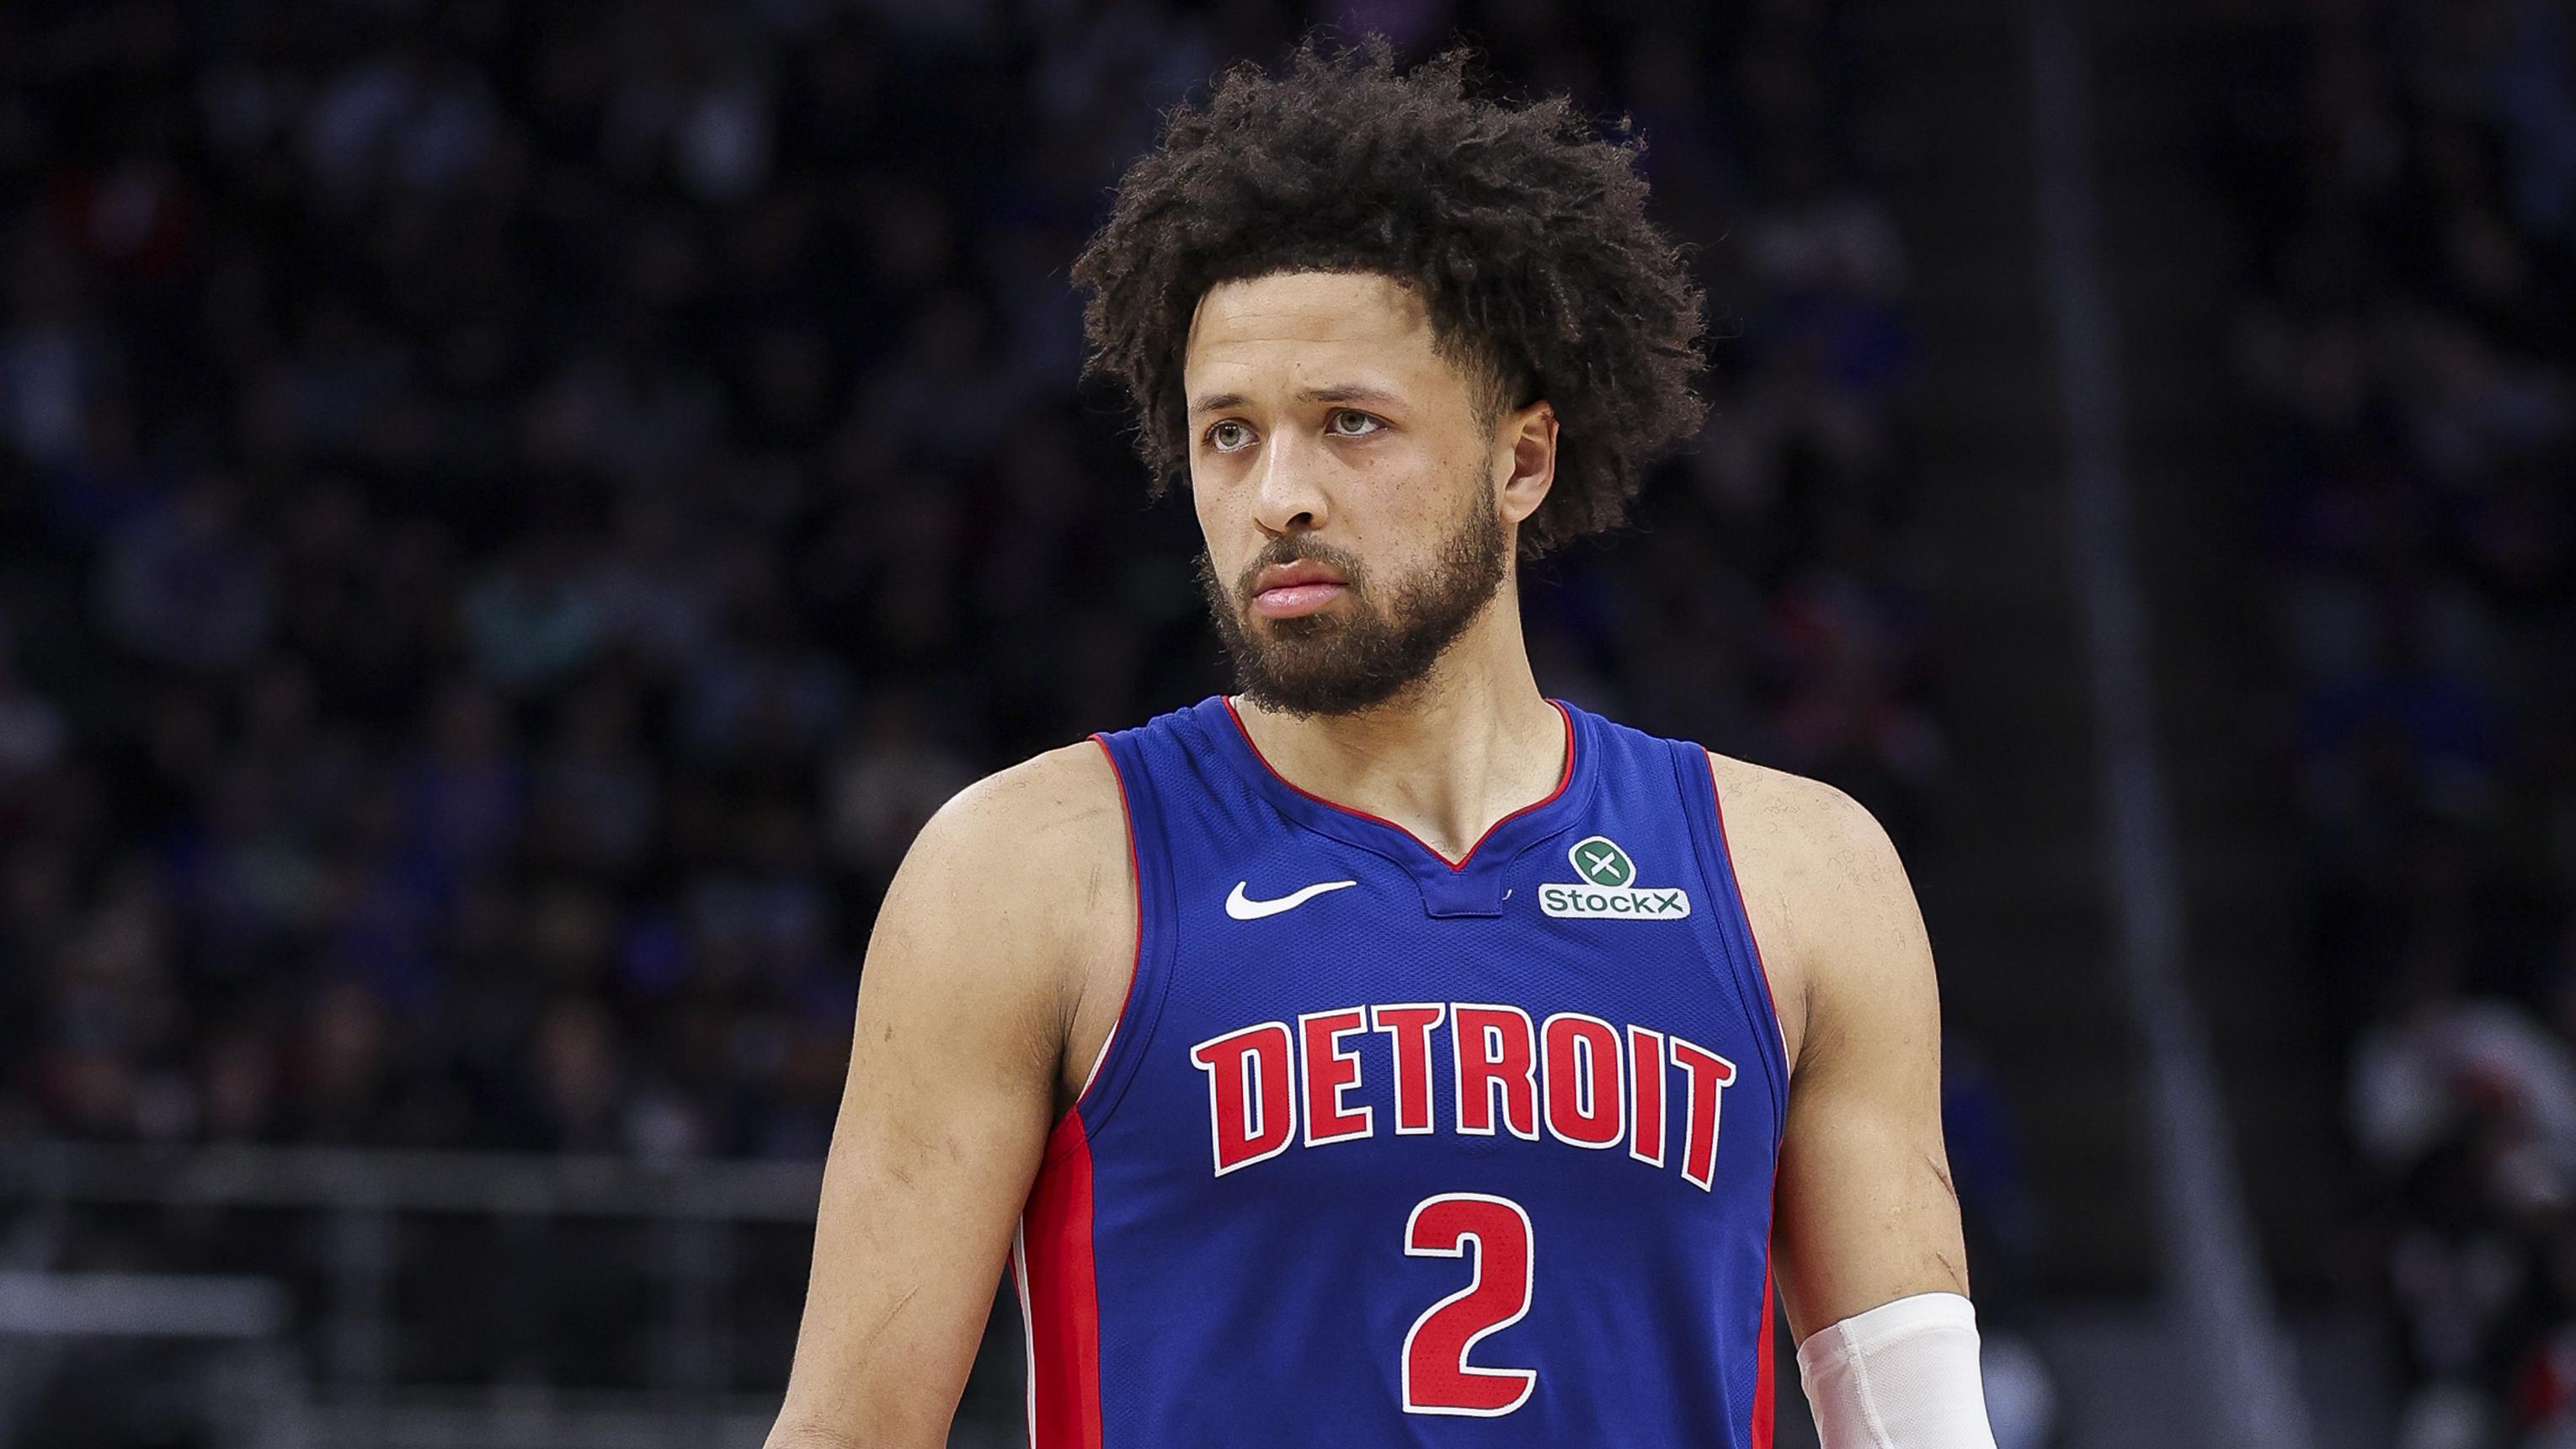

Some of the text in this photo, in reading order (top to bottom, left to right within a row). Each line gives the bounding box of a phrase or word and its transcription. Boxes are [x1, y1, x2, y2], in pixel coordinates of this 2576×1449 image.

[1544, 889, 1683, 914] StockX
[1190, 1002, 1736, 1192] DETROIT
[1401, 1192, 1537, 1416] 2
